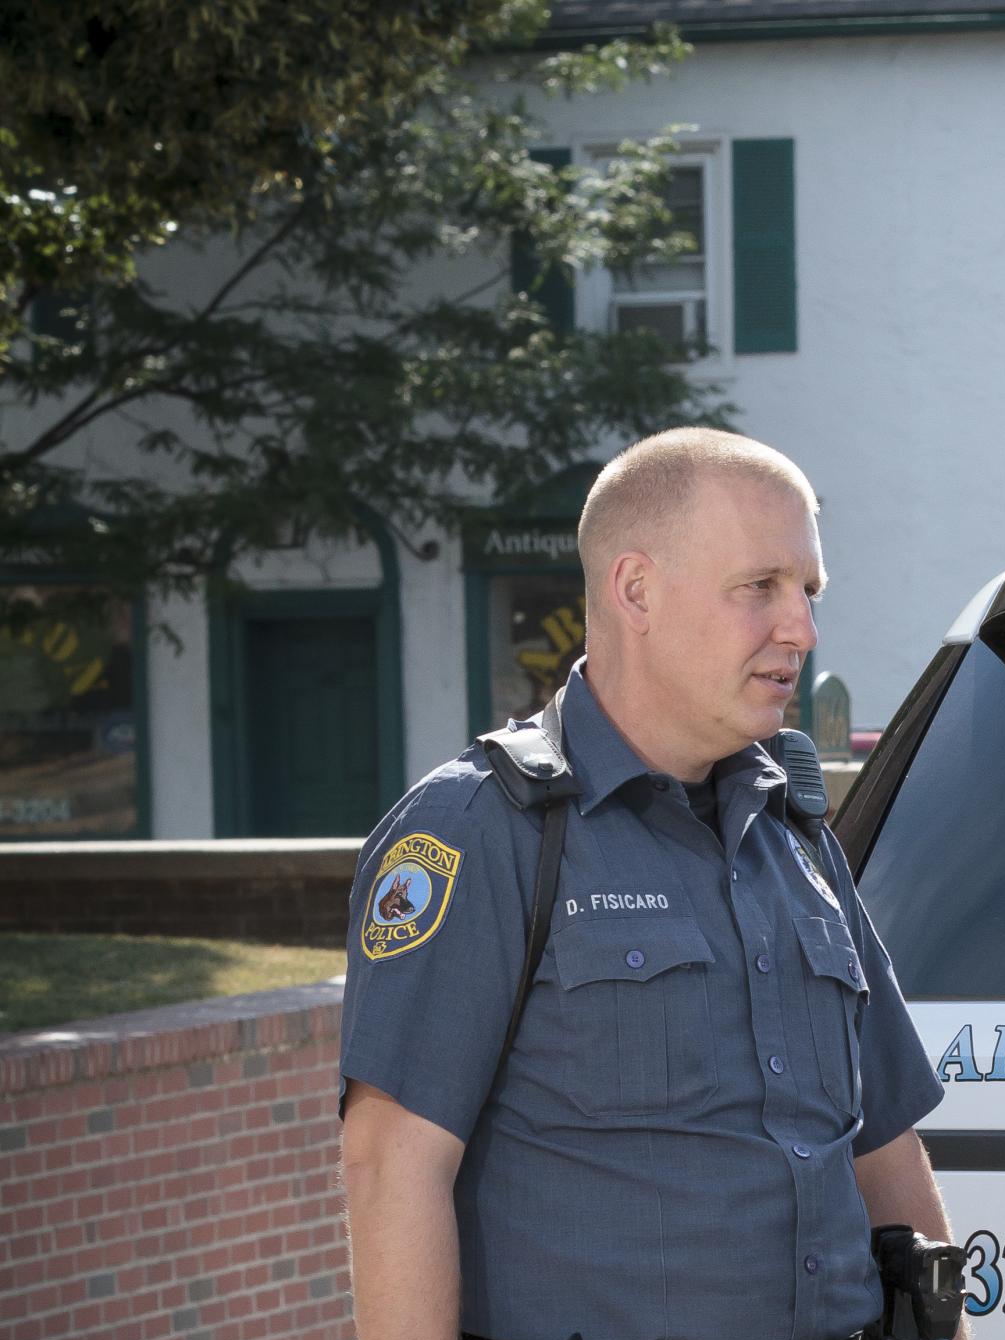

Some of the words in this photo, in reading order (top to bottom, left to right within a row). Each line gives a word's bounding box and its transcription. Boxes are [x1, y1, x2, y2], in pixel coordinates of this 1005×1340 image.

[484, 530, 579, 560] Antiqu
[566, 899, 585, 916] D.
[590, 893, 669, 911] FISICARO
[365, 921, 420, 941] POLICE
